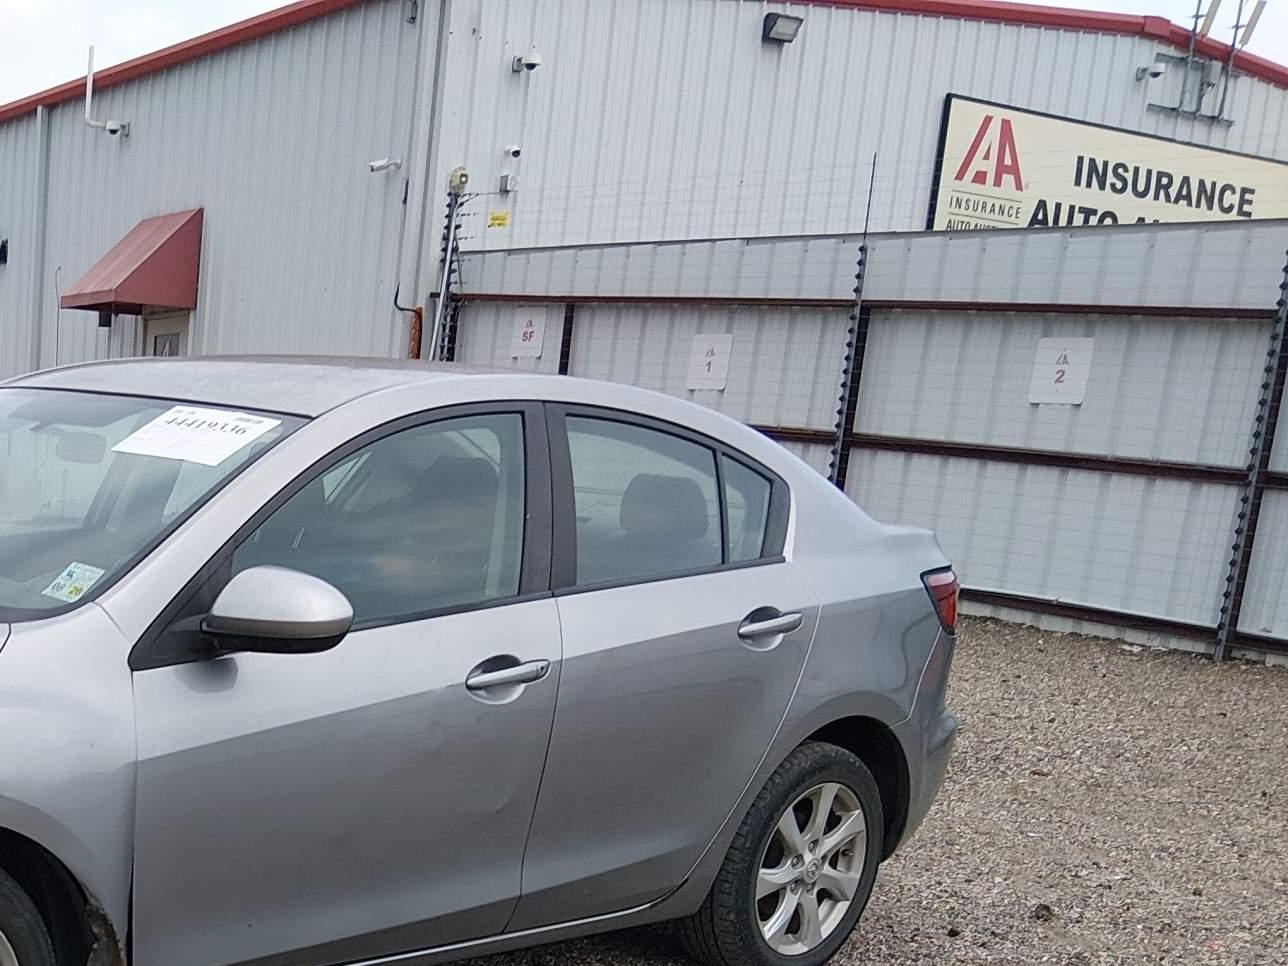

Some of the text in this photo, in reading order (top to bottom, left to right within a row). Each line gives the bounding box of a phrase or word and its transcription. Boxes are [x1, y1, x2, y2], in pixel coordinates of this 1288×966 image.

[1073, 155, 1256, 218] INSURANCE
[949, 196, 1022, 219] INSURANCE
[522, 330, 535, 342] SF
[705, 360, 712, 373] 1
[1054, 369, 1066, 384] 2
